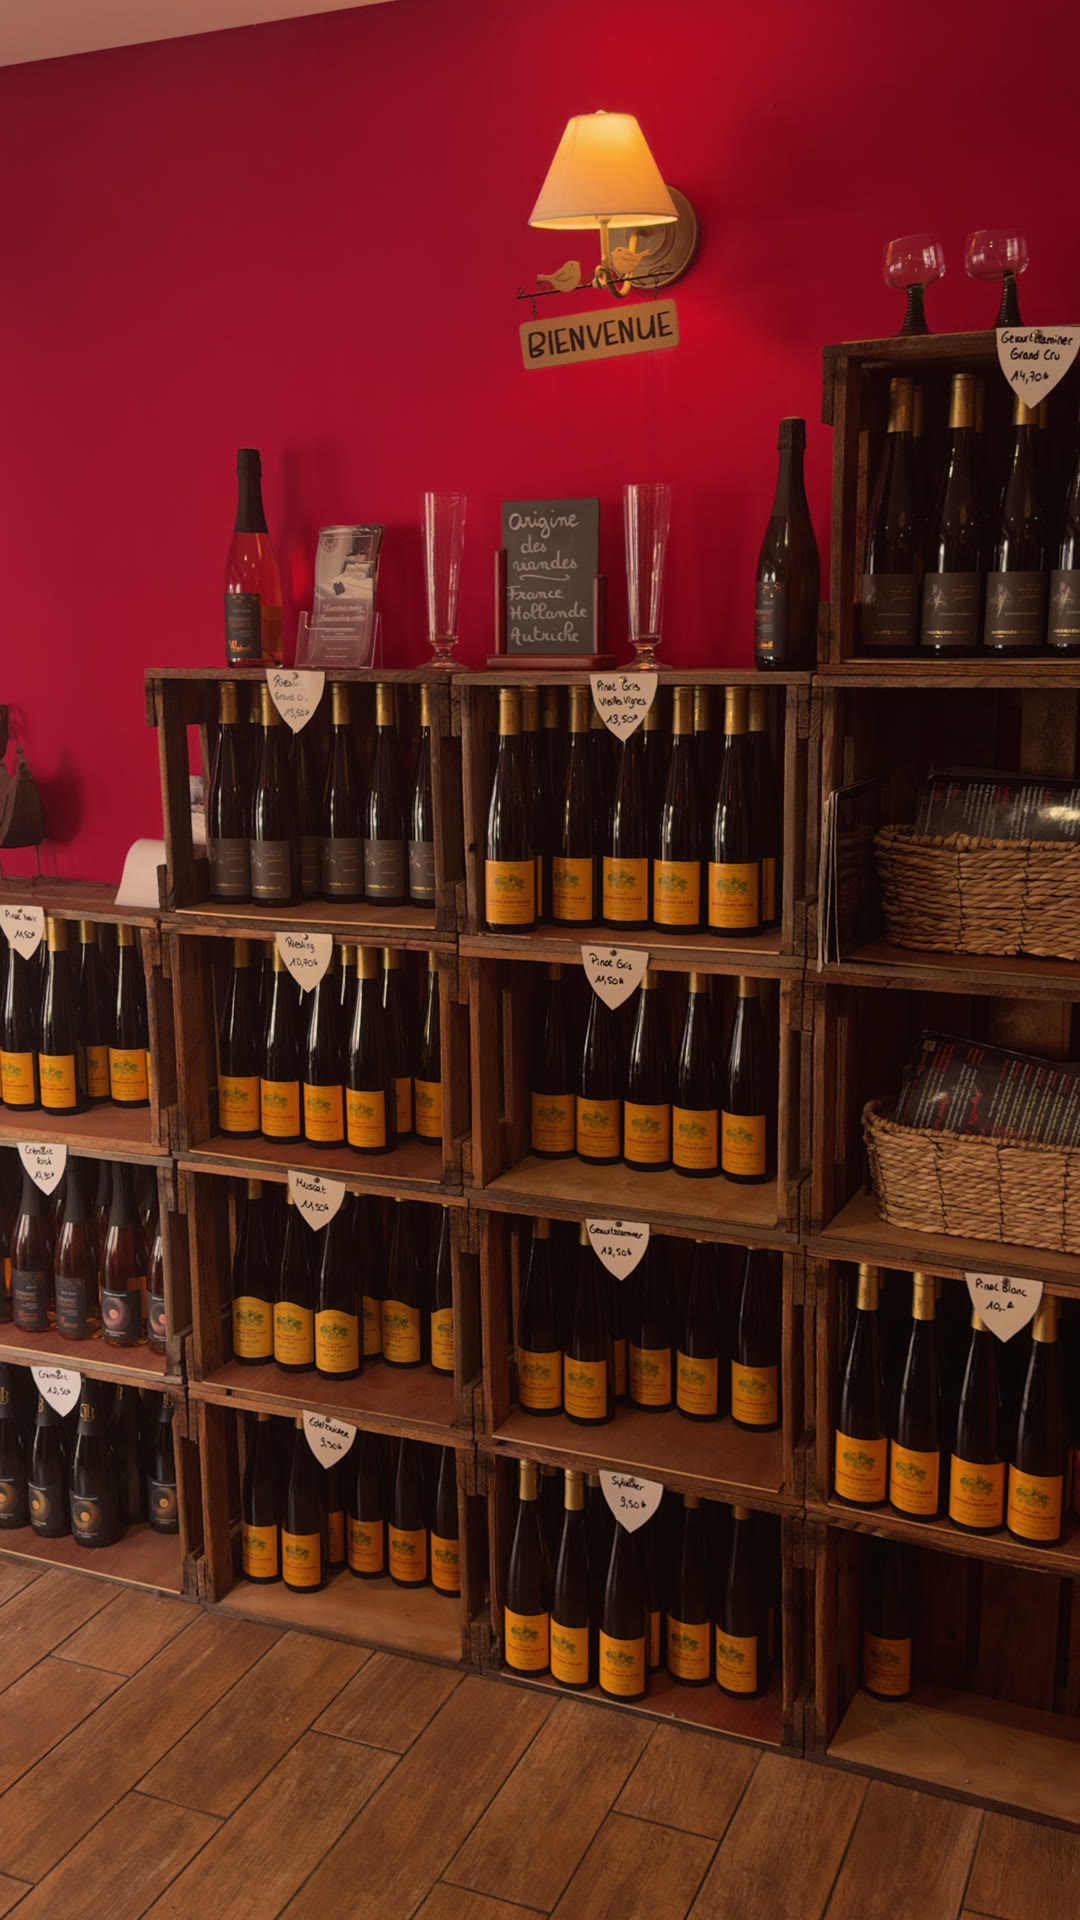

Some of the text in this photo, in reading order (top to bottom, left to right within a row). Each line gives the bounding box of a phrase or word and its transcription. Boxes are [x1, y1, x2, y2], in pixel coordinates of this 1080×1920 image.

[528, 310, 674, 360] BIENVENUE
[1010, 347, 1061, 361] Grand Cru
[508, 510, 581, 539] Origine
[520, 534, 547, 554] des
[512, 550, 578, 571] viandes
[506, 586, 565, 602] France
[510, 601, 589, 621] Hollande
[510, 621, 580, 646] Autriche
[597, 680, 641, 692] Pinot Gris
[589, 952, 632, 971] Pinot Gris
[296, 1177, 327, 1195] Muscat
[976, 1278, 1028, 1298] Pinot Blanc
